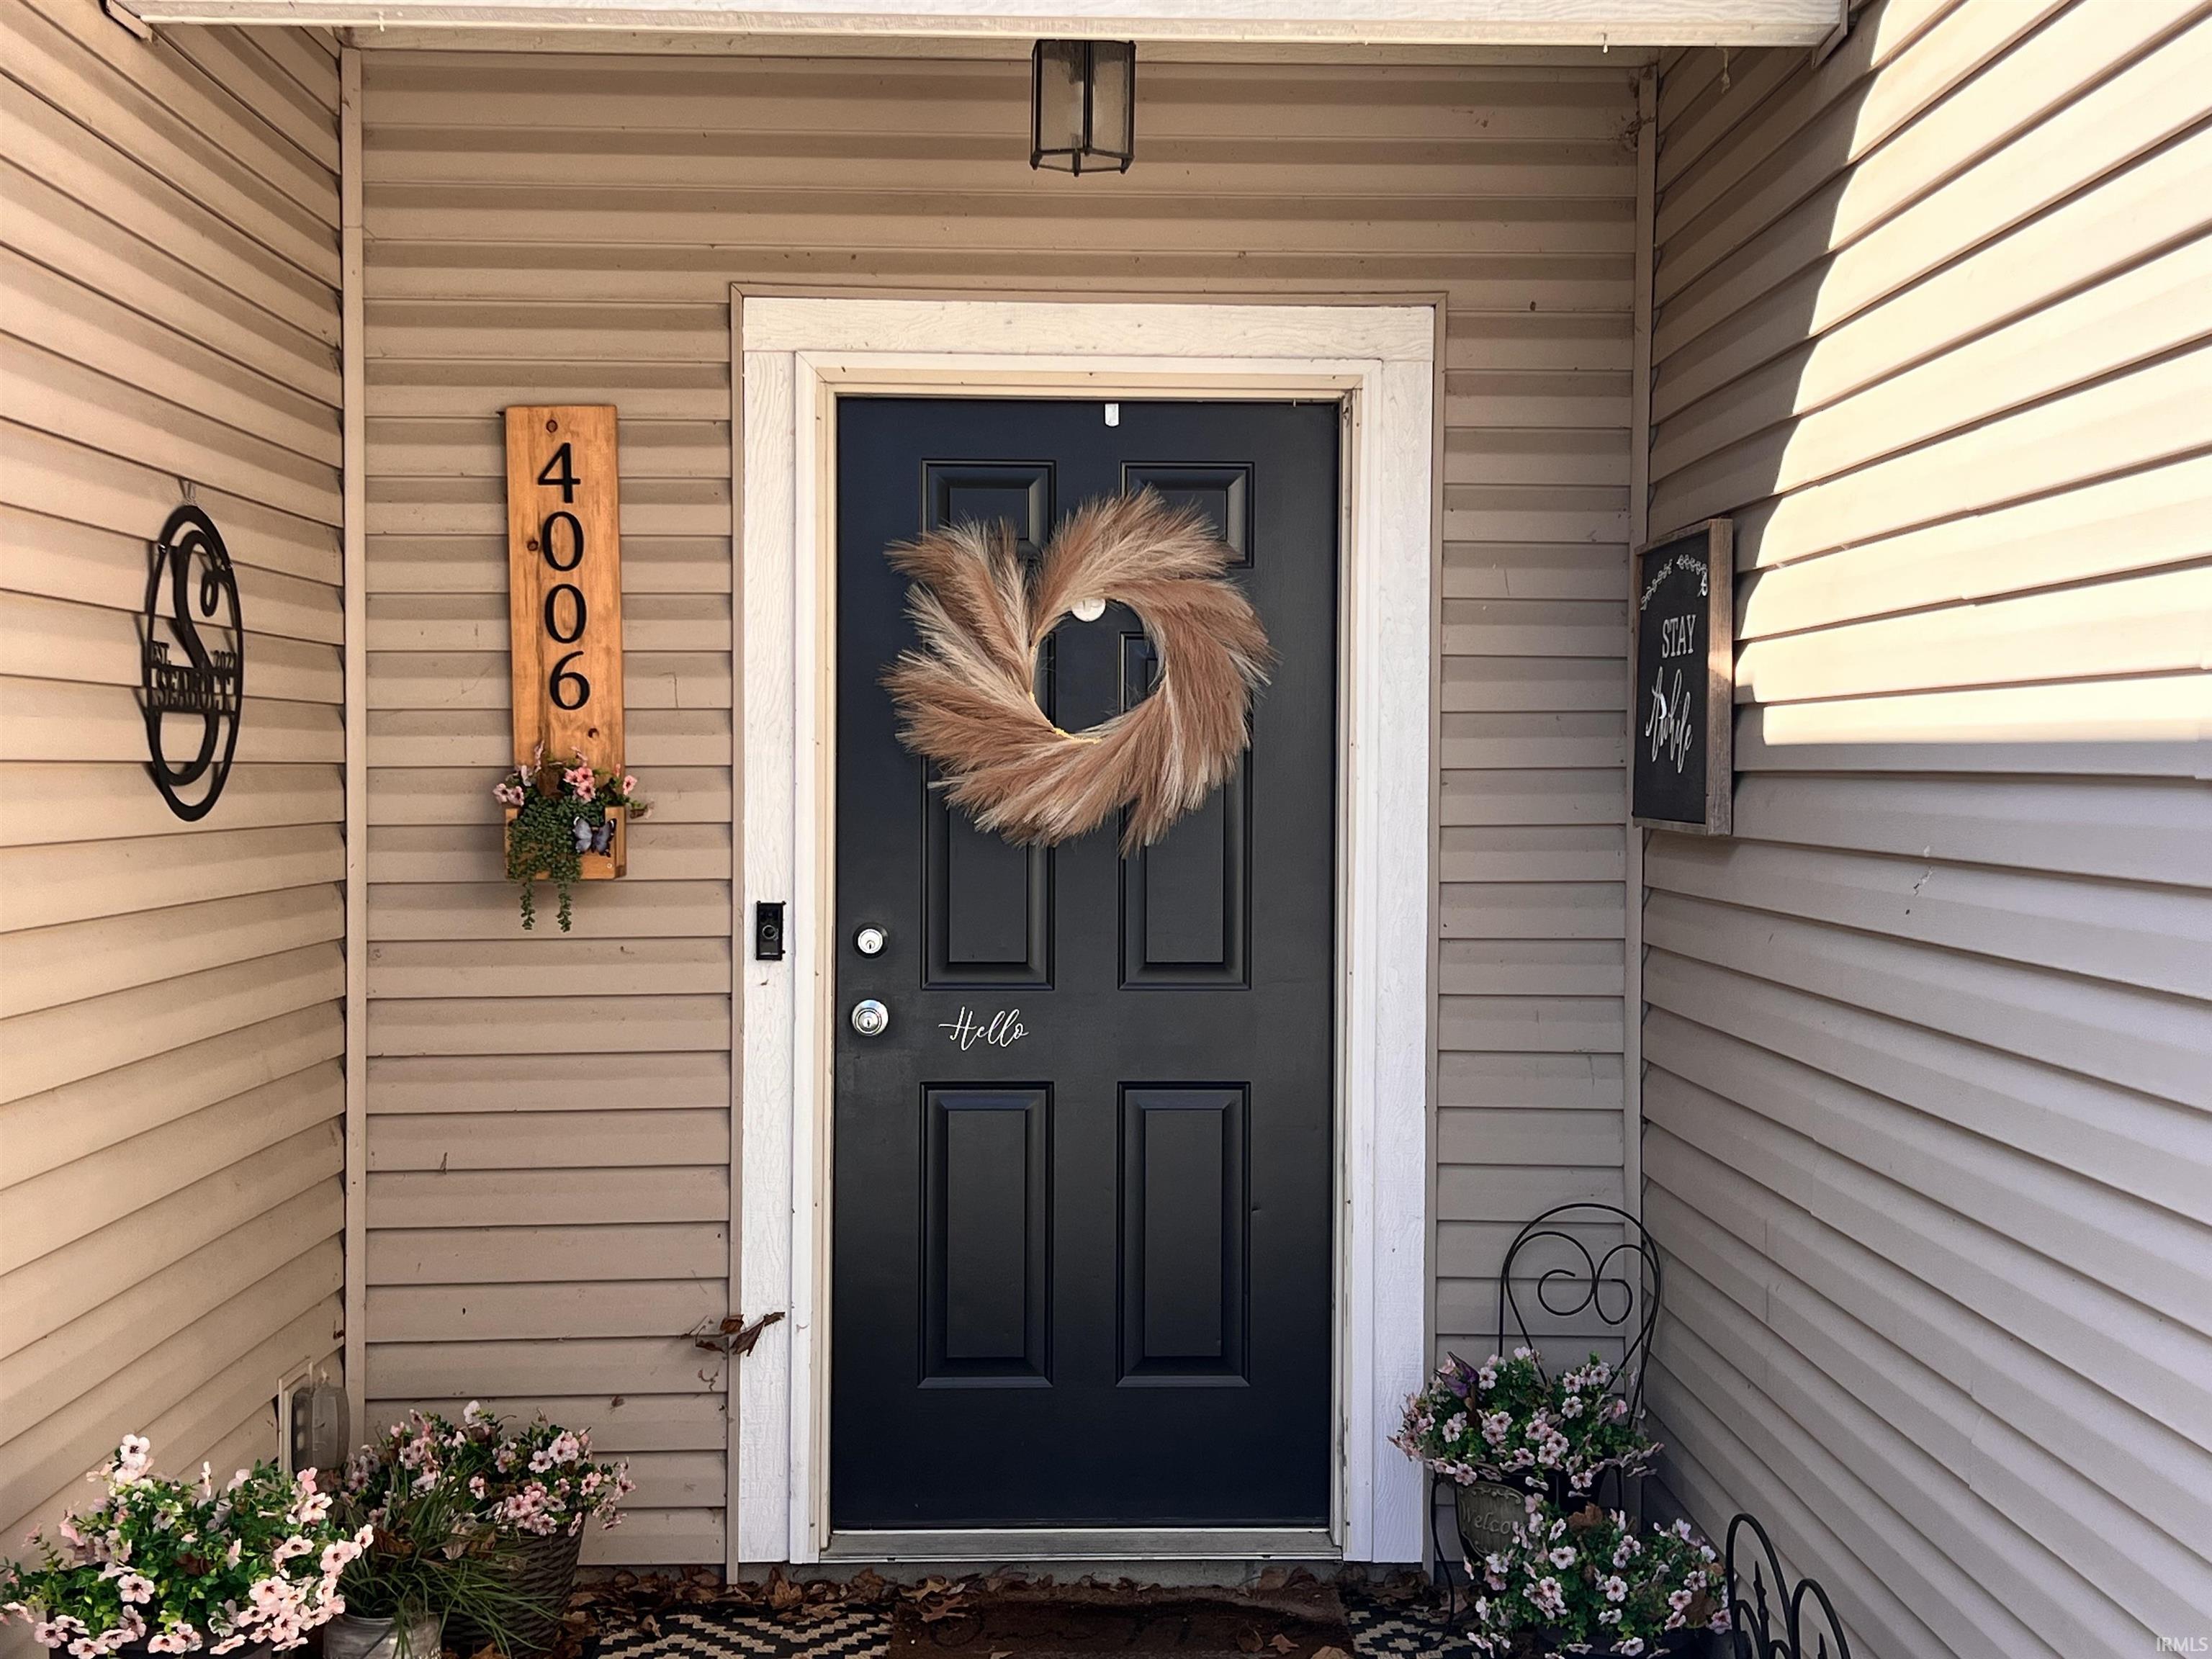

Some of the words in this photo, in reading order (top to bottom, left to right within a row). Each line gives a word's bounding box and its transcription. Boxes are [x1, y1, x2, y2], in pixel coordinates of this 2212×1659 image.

[537, 441, 591, 711] 4006
[1661, 614, 1696, 659] STAY
[938, 1006, 1030, 1051] Hello
